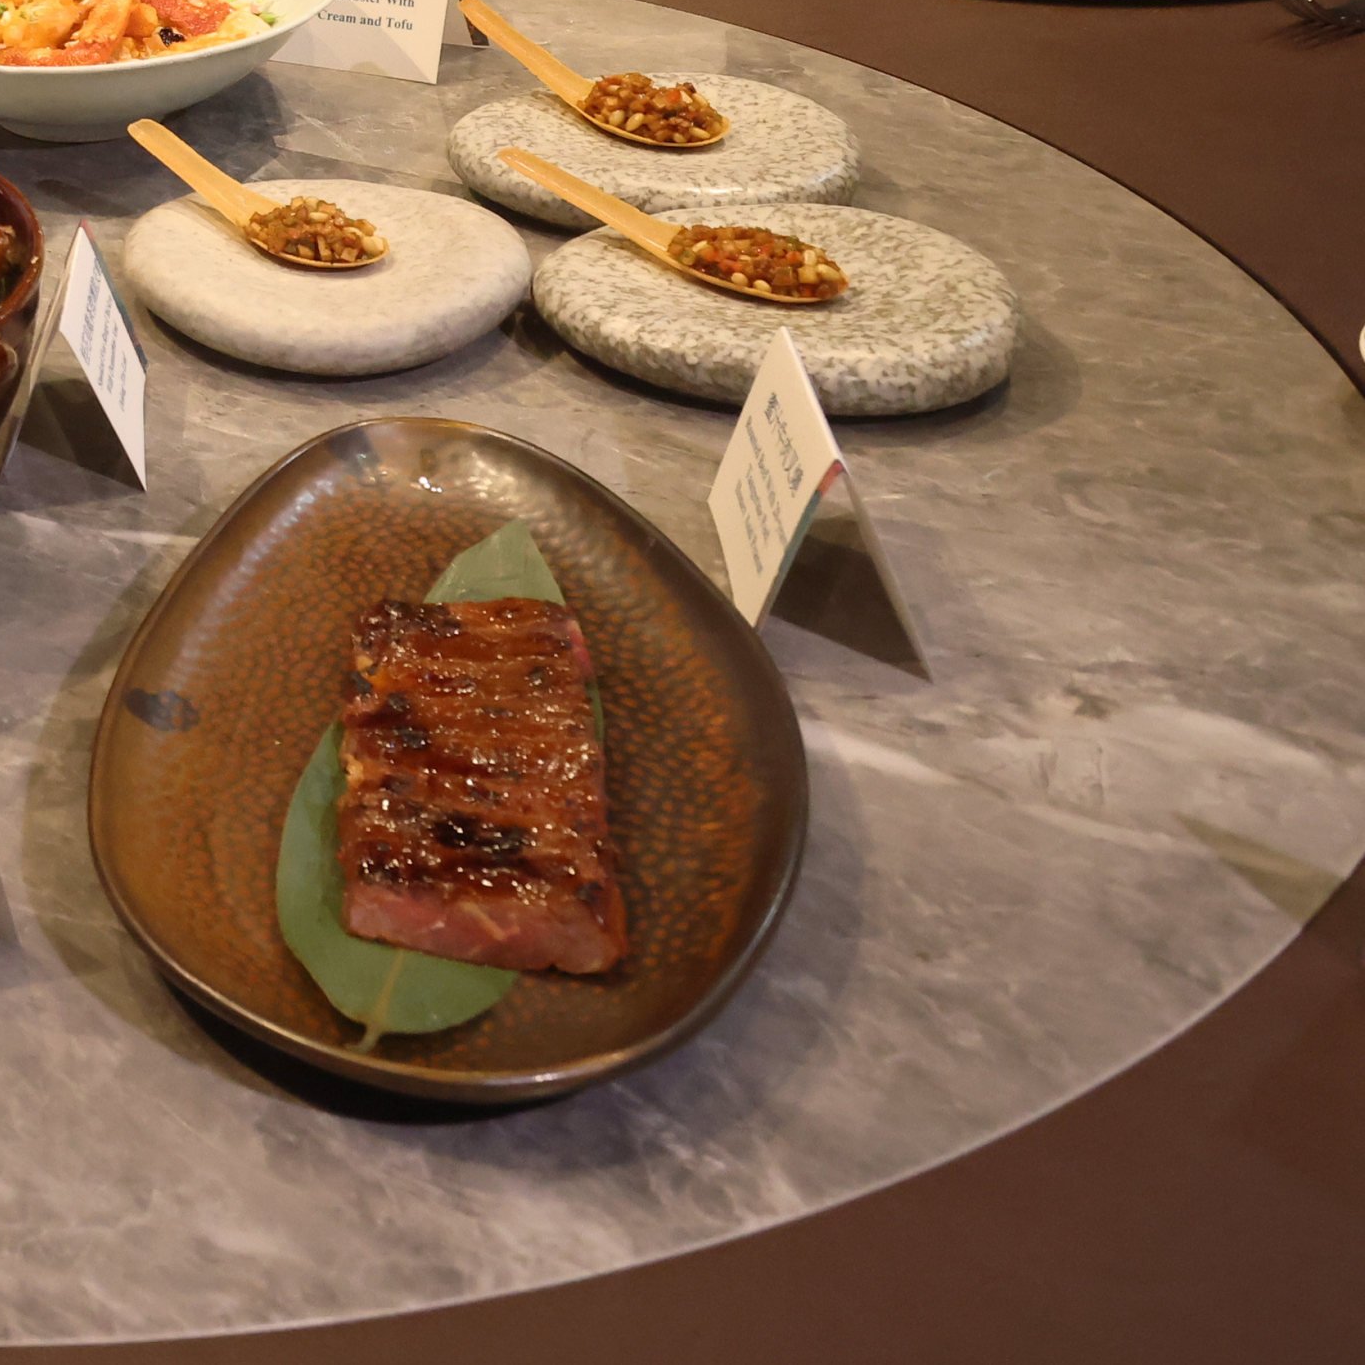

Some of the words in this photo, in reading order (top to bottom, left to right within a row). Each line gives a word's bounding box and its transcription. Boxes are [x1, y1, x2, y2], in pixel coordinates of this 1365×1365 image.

[318, 11, 357, 25] Cream
[359, 14, 381, 27] and
[386, 17, 413, 31] Tofu
